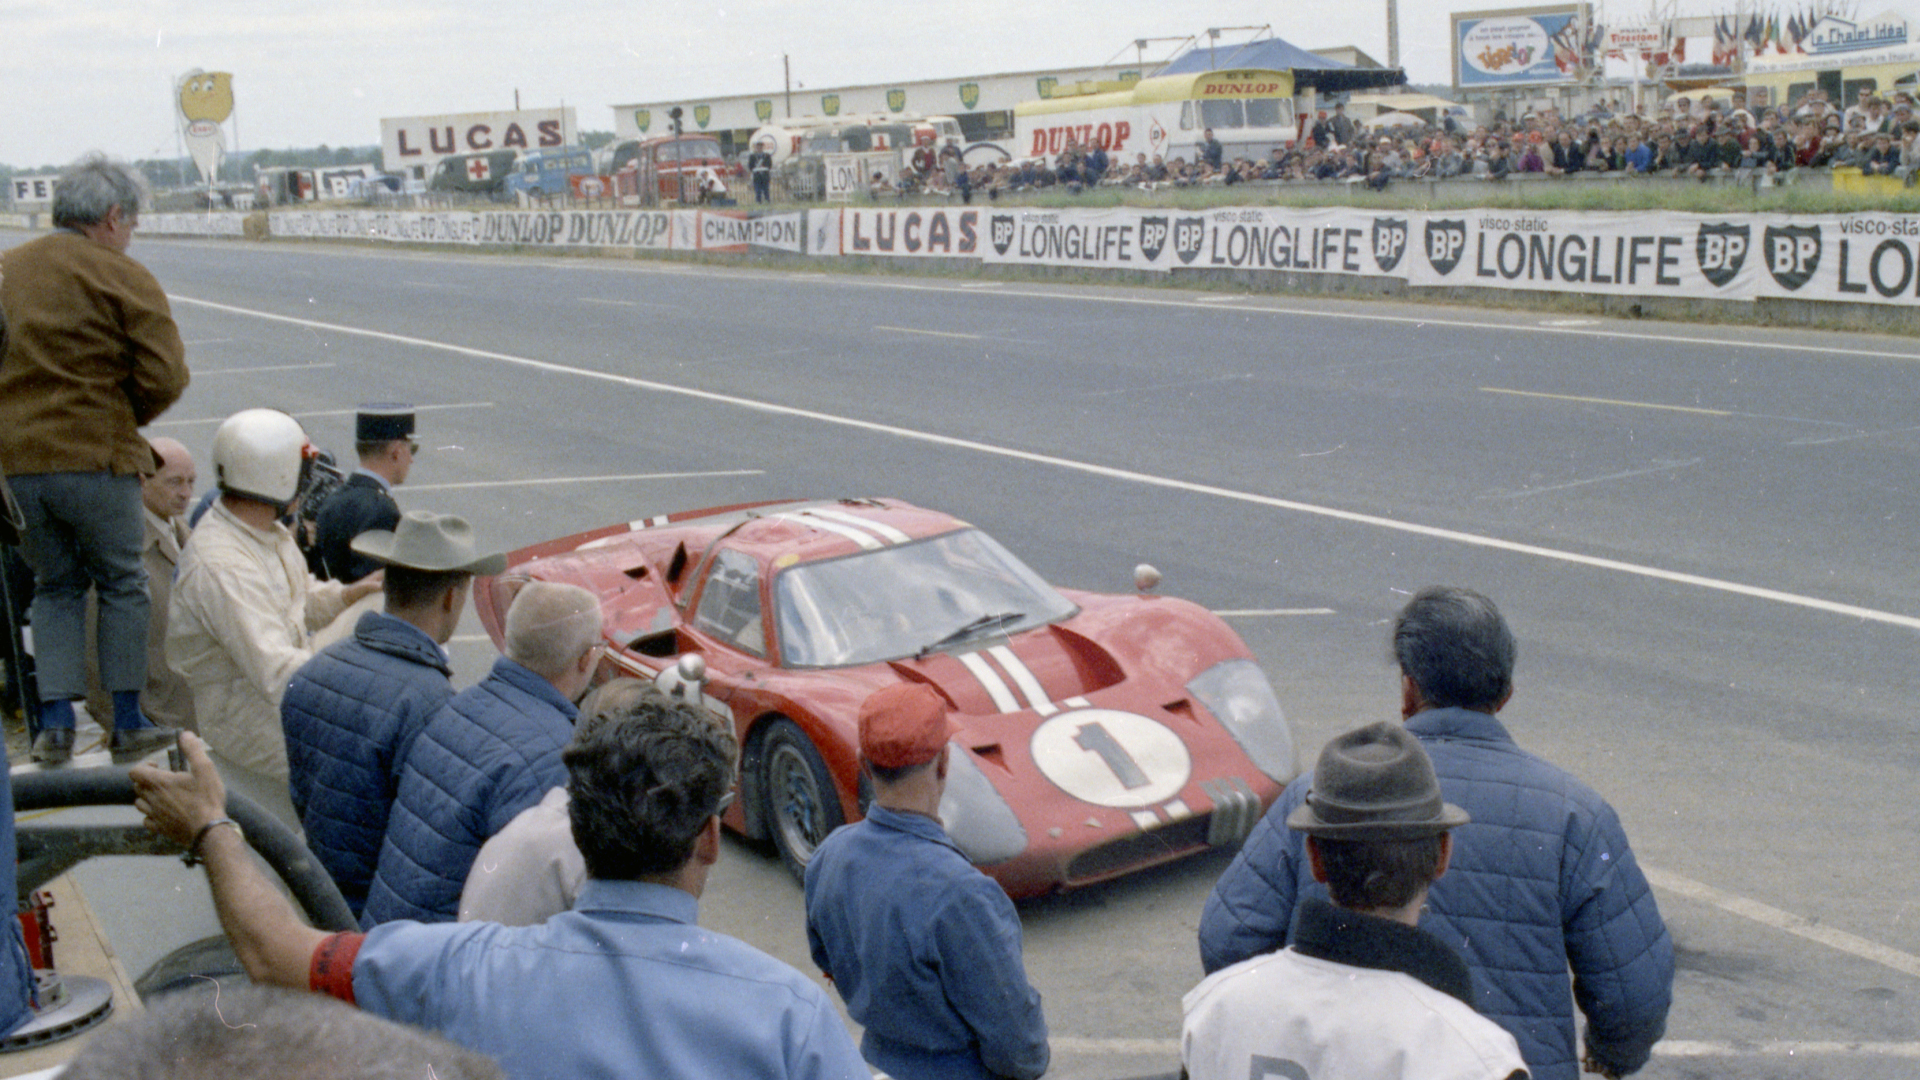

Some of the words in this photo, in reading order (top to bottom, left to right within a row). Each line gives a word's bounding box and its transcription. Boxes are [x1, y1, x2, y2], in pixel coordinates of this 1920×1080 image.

[1610, 34, 1658, 43] Firestone
[1203, 83, 1279, 95] DUNLOP
[398, 120, 563, 156] LUCAS
[1031, 121, 1131, 157] DUNLOP
[482, 213, 564, 243] DUNLOP
[568, 213, 668, 245] DUNLOP
[704, 219, 796, 243] CHAMPION
[853, 211, 978, 253] LUCAS
[1020, 224, 1133, 261] LONGLIFE
[1211, 225, 1363, 271] LONGLIFE
[1477, 231, 1683, 286] LONGLIFE
[1071, 722, 1153, 790] 1
